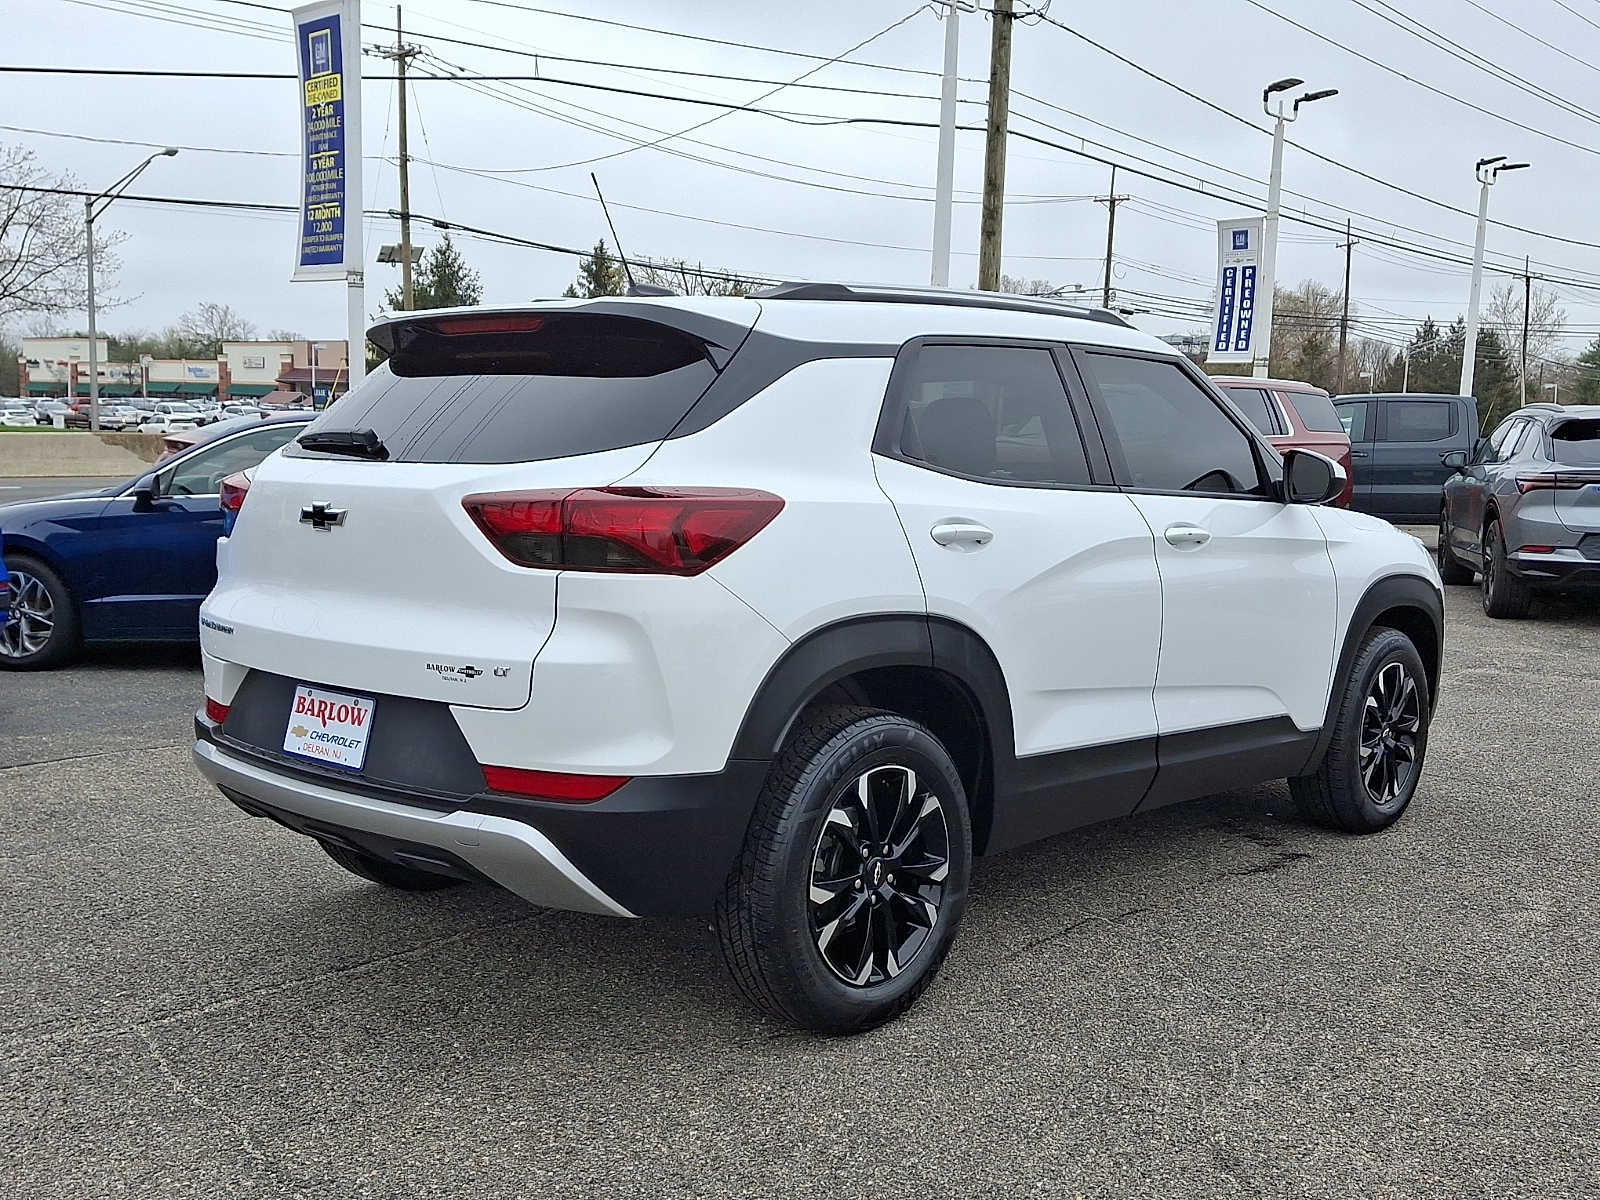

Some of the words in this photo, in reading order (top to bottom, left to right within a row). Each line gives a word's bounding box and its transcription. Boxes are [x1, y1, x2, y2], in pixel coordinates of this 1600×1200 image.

[307, 77, 338, 93] CERTIFIED
[312, 108, 317, 119] 2
[317, 104, 334, 118] YEAR
[325, 116, 341, 129] MILE
[312, 160, 317, 170] 6
[318, 157, 334, 169] YEAR
[328, 168, 344, 179] MILE
[307, 210, 314, 220] 12
[315, 207, 340, 219] MONTH
[1218, 268, 1234, 350] CERTIFIED
[1238, 268, 1253, 350] PREOWNED
[426, 663, 456, 675] BARLOW
[493, 666, 511, 677] LT
[295, 695, 368, 728] BARLOW
[310, 730, 362, 750] CHEVROLET
